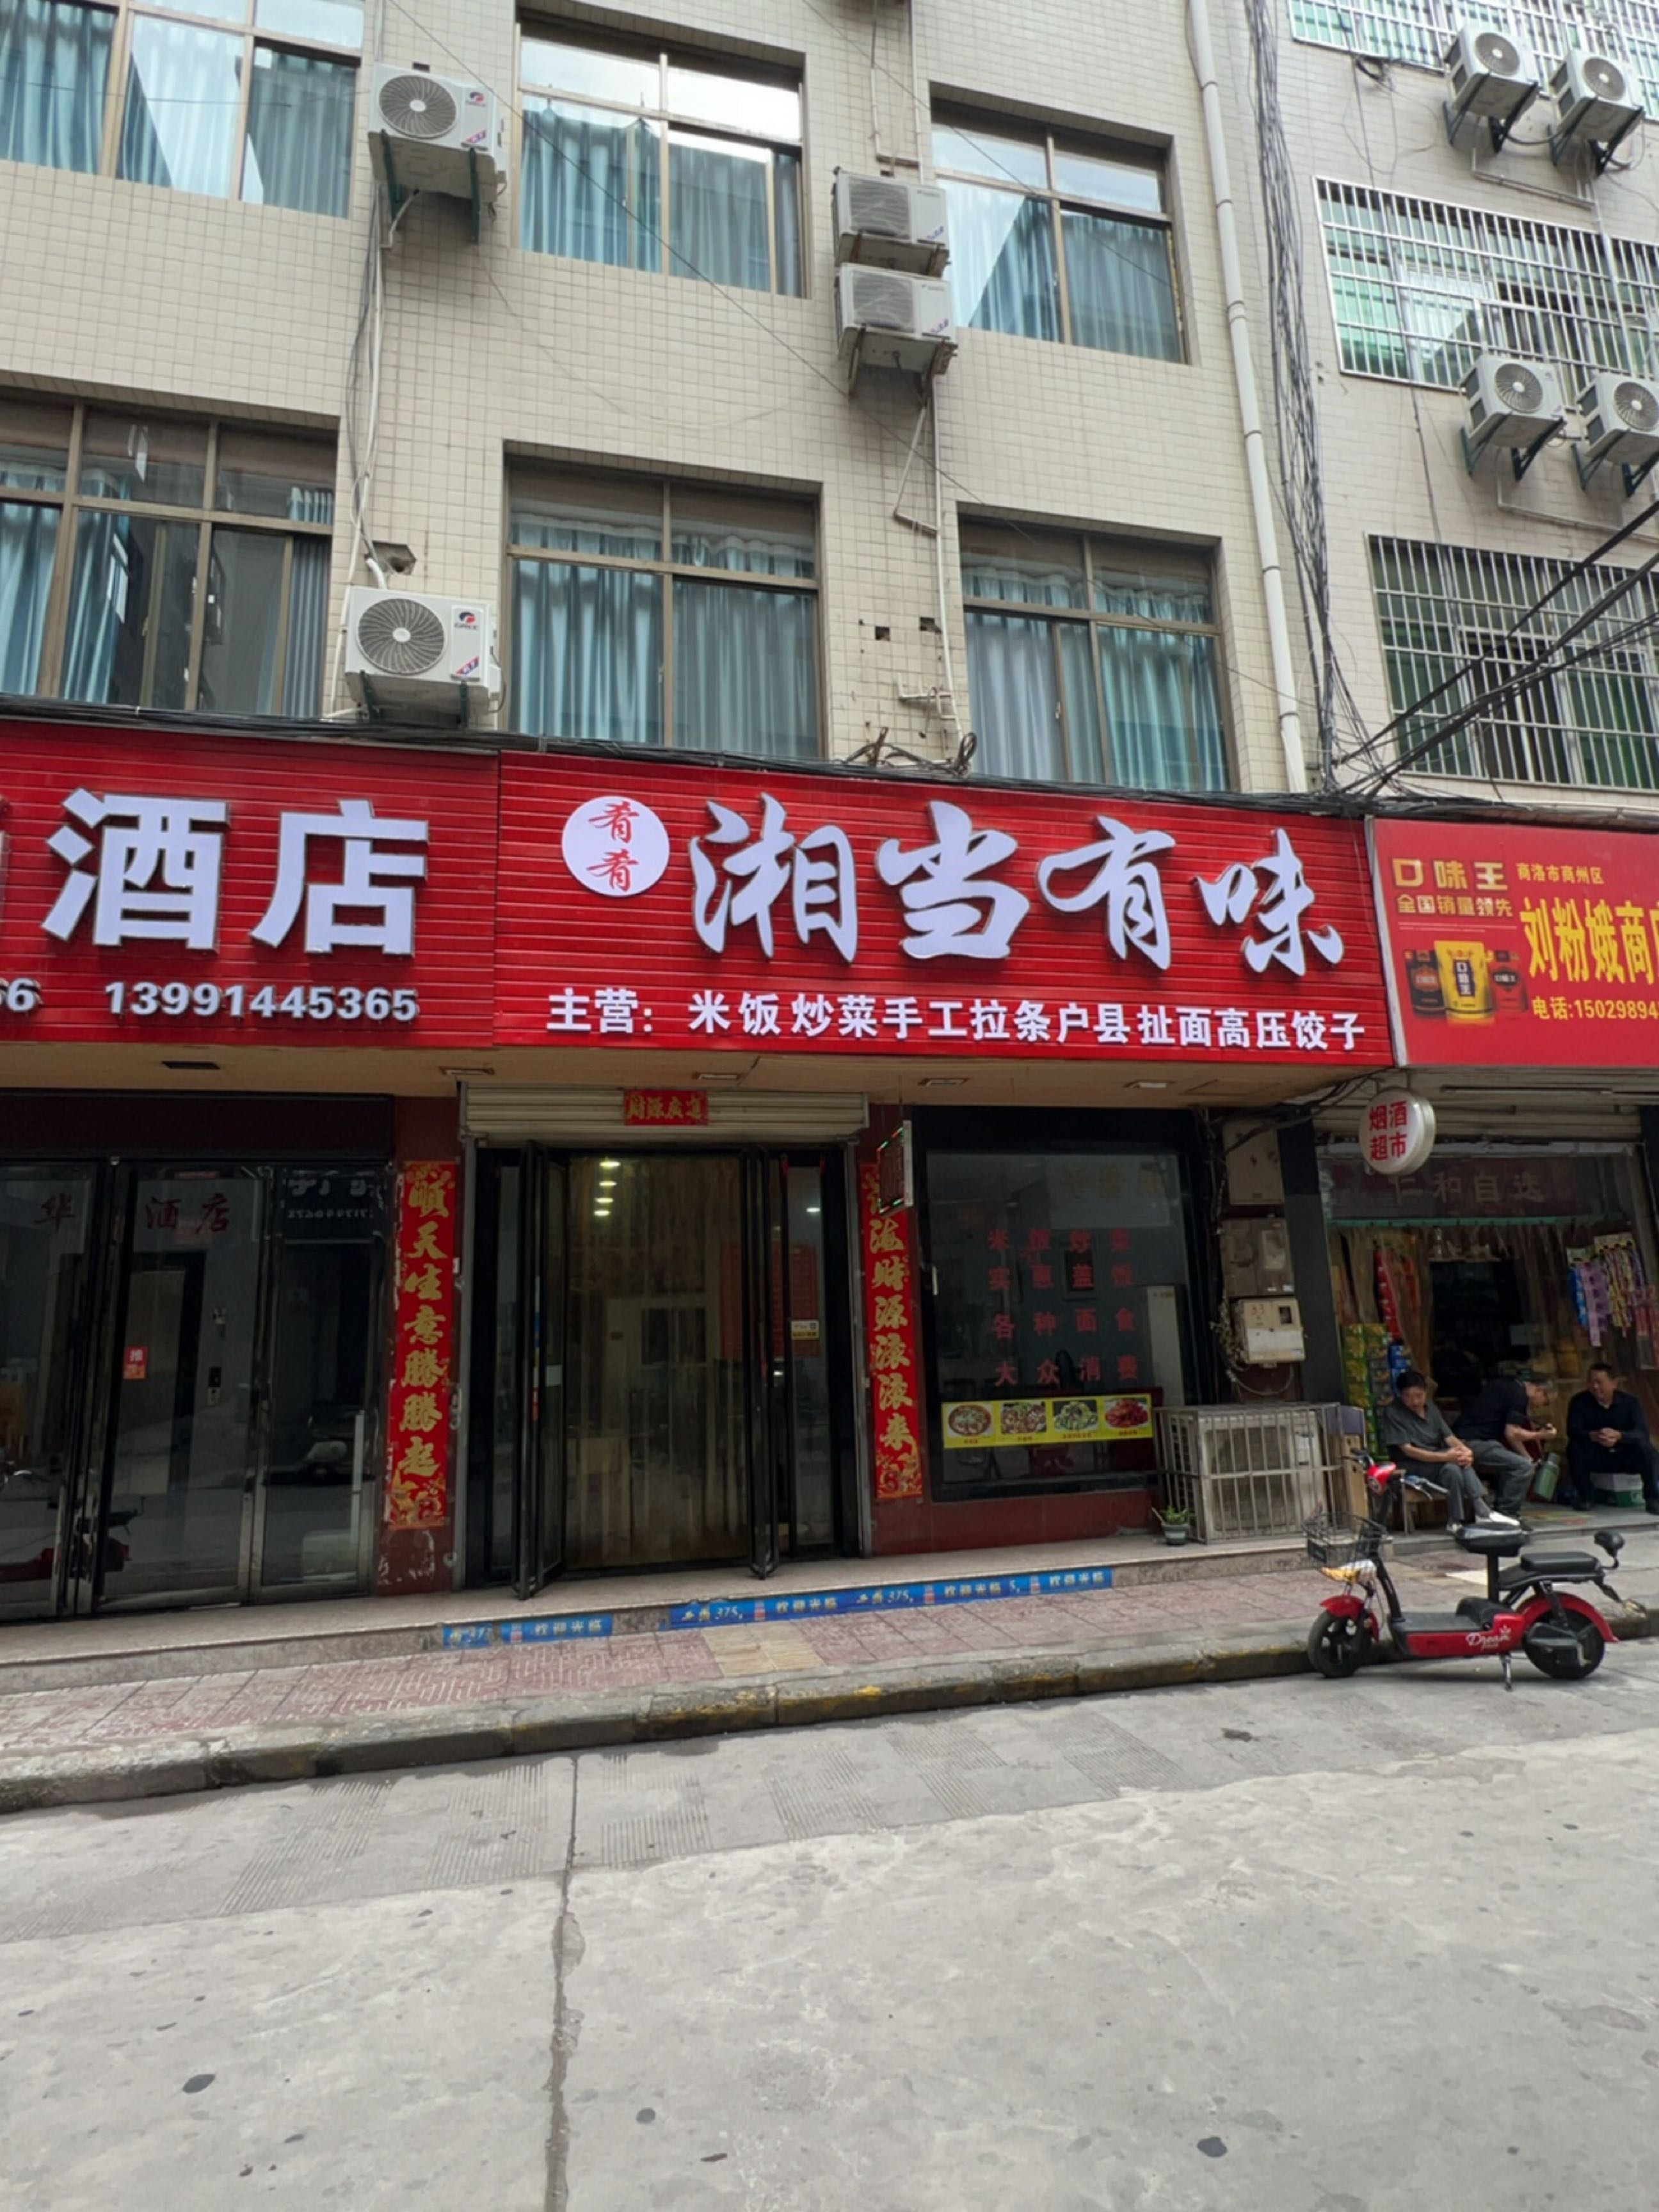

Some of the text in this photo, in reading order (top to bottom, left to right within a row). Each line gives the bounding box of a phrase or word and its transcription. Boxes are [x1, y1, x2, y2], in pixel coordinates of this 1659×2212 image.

[40, 787, 430, 956] 酒店
[688, 792, 1345, 976] 湘当有味
[1392, 857, 1509, 890] 口味王
[1516, 862, 1605, 885] 商洛市商州区
[1397, 894, 1514, 917] 全国销量领先
[104, 981, 419, 1021] 13991445365
[1532, 996, 1659, 1020] 电话:15029894
[546, 987, 1365, 1051] 主营： 米饭炒菜手工拉条户县扯面高压饺子
[1369, 1100, 1407, 1130] 烟酒
[1370, 1132, 1407, 1160] 超市
